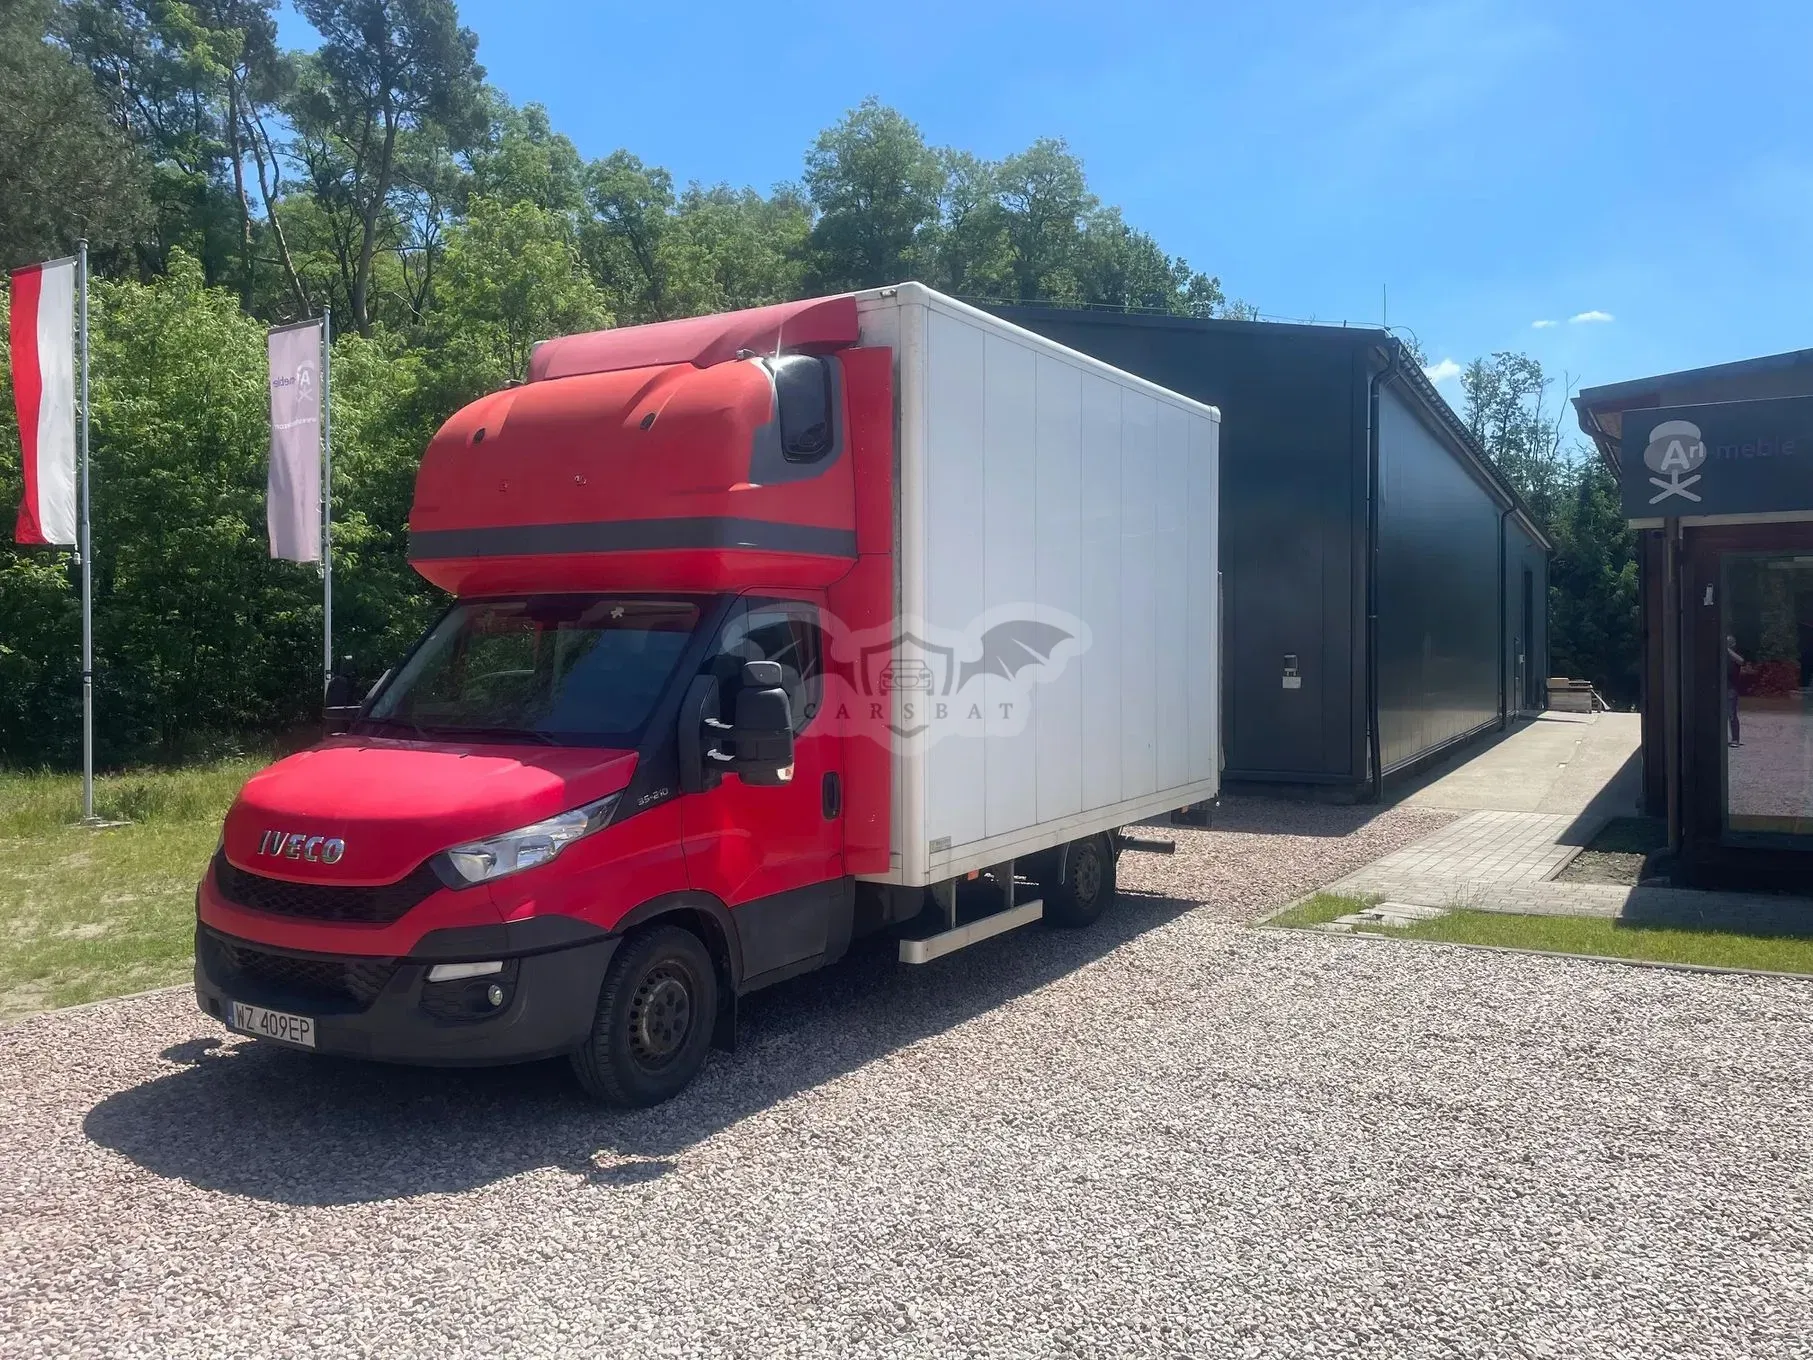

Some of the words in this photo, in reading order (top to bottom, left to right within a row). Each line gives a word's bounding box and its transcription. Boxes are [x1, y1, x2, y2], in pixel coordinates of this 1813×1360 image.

[1717, 436, 1795, 460] meble
[257, 830, 345, 864] IVECO
[236, 1006, 254, 1030] WZ
[261, 1013, 310, 1041] 409EP
